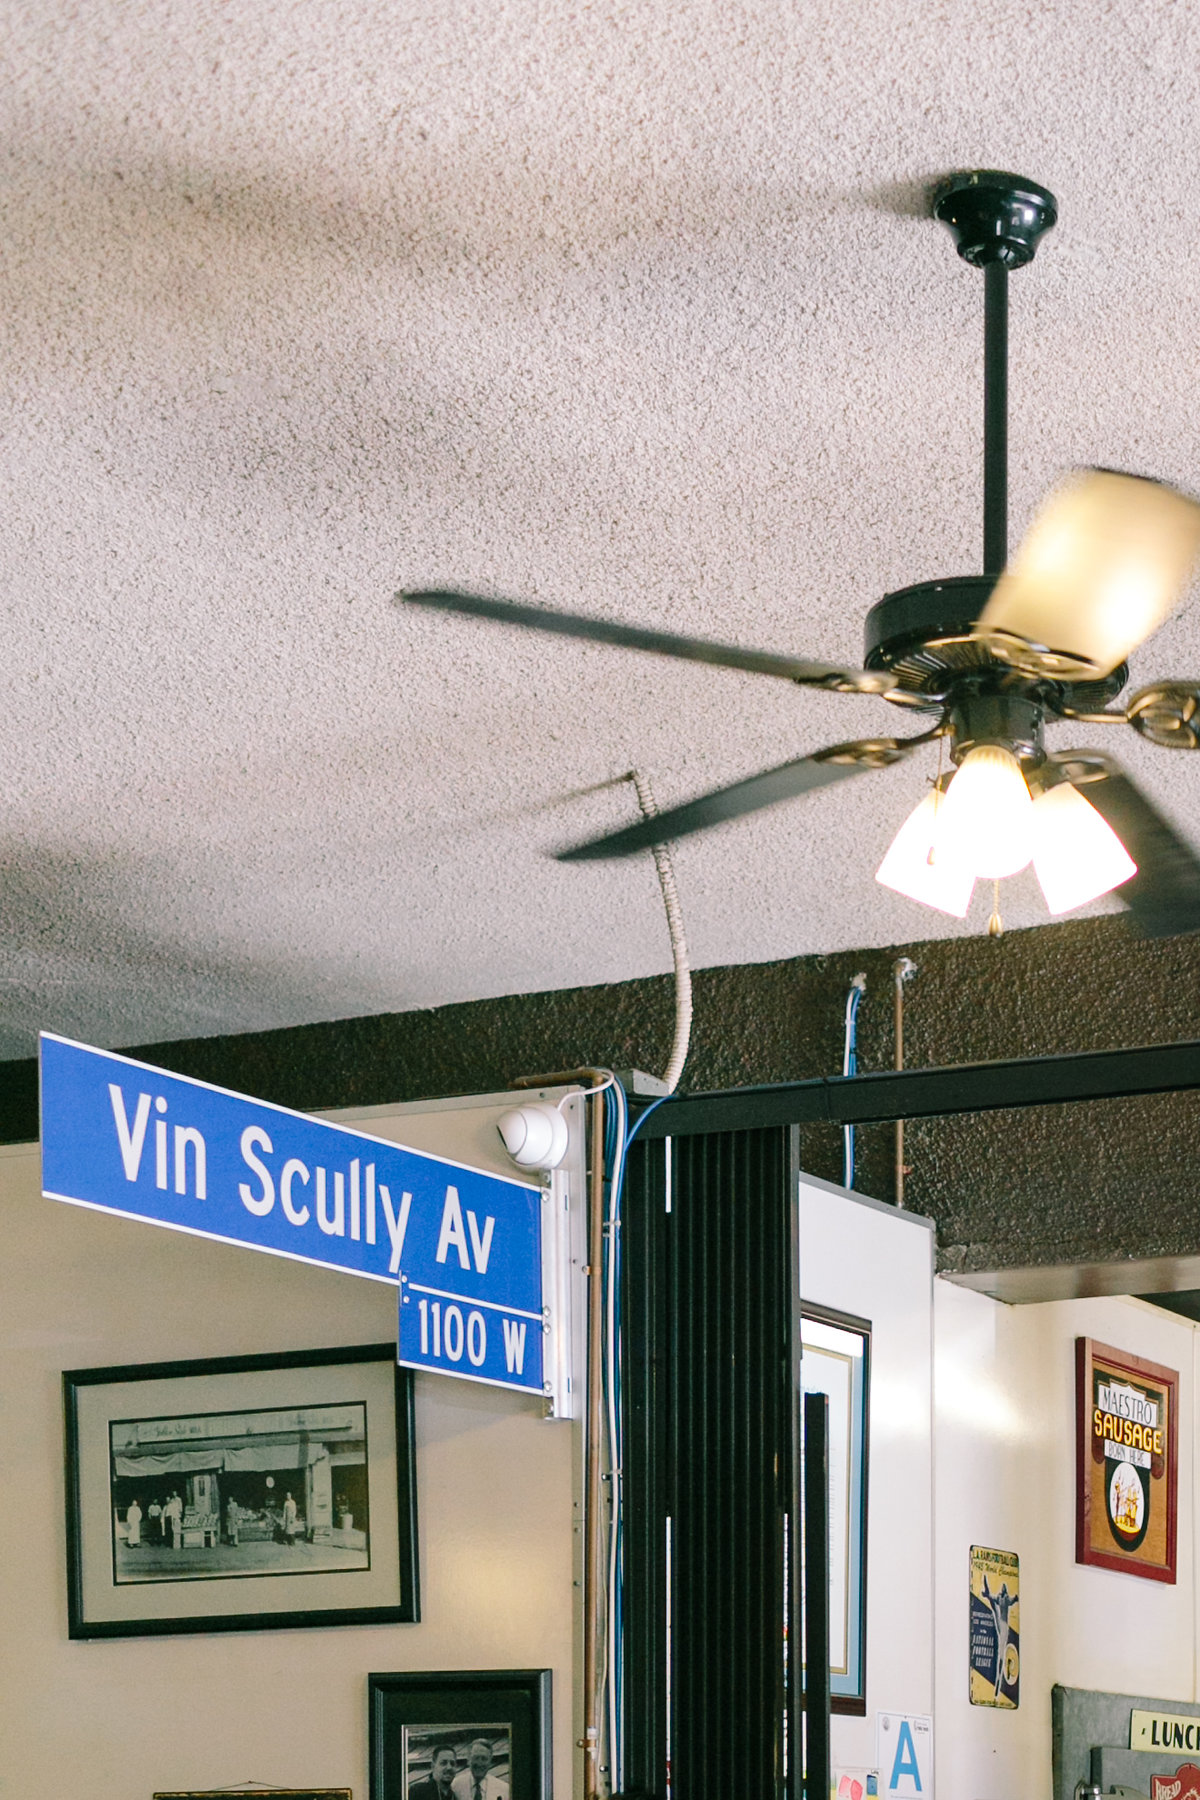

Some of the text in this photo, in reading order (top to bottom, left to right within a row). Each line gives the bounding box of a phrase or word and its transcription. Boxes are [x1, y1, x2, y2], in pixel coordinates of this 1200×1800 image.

[108, 1083, 496, 1274] Vin Scully Av
[418, 1299, 527, 1375] 1100 W
[1094, 1409, 1163, 1454] SAUSAGE
[1103, 1387, 1153, 1425] MAESTRO
[1109, 1441, 1145, 1467] BORN HERE
[889, 1721, 922, 1791] A
